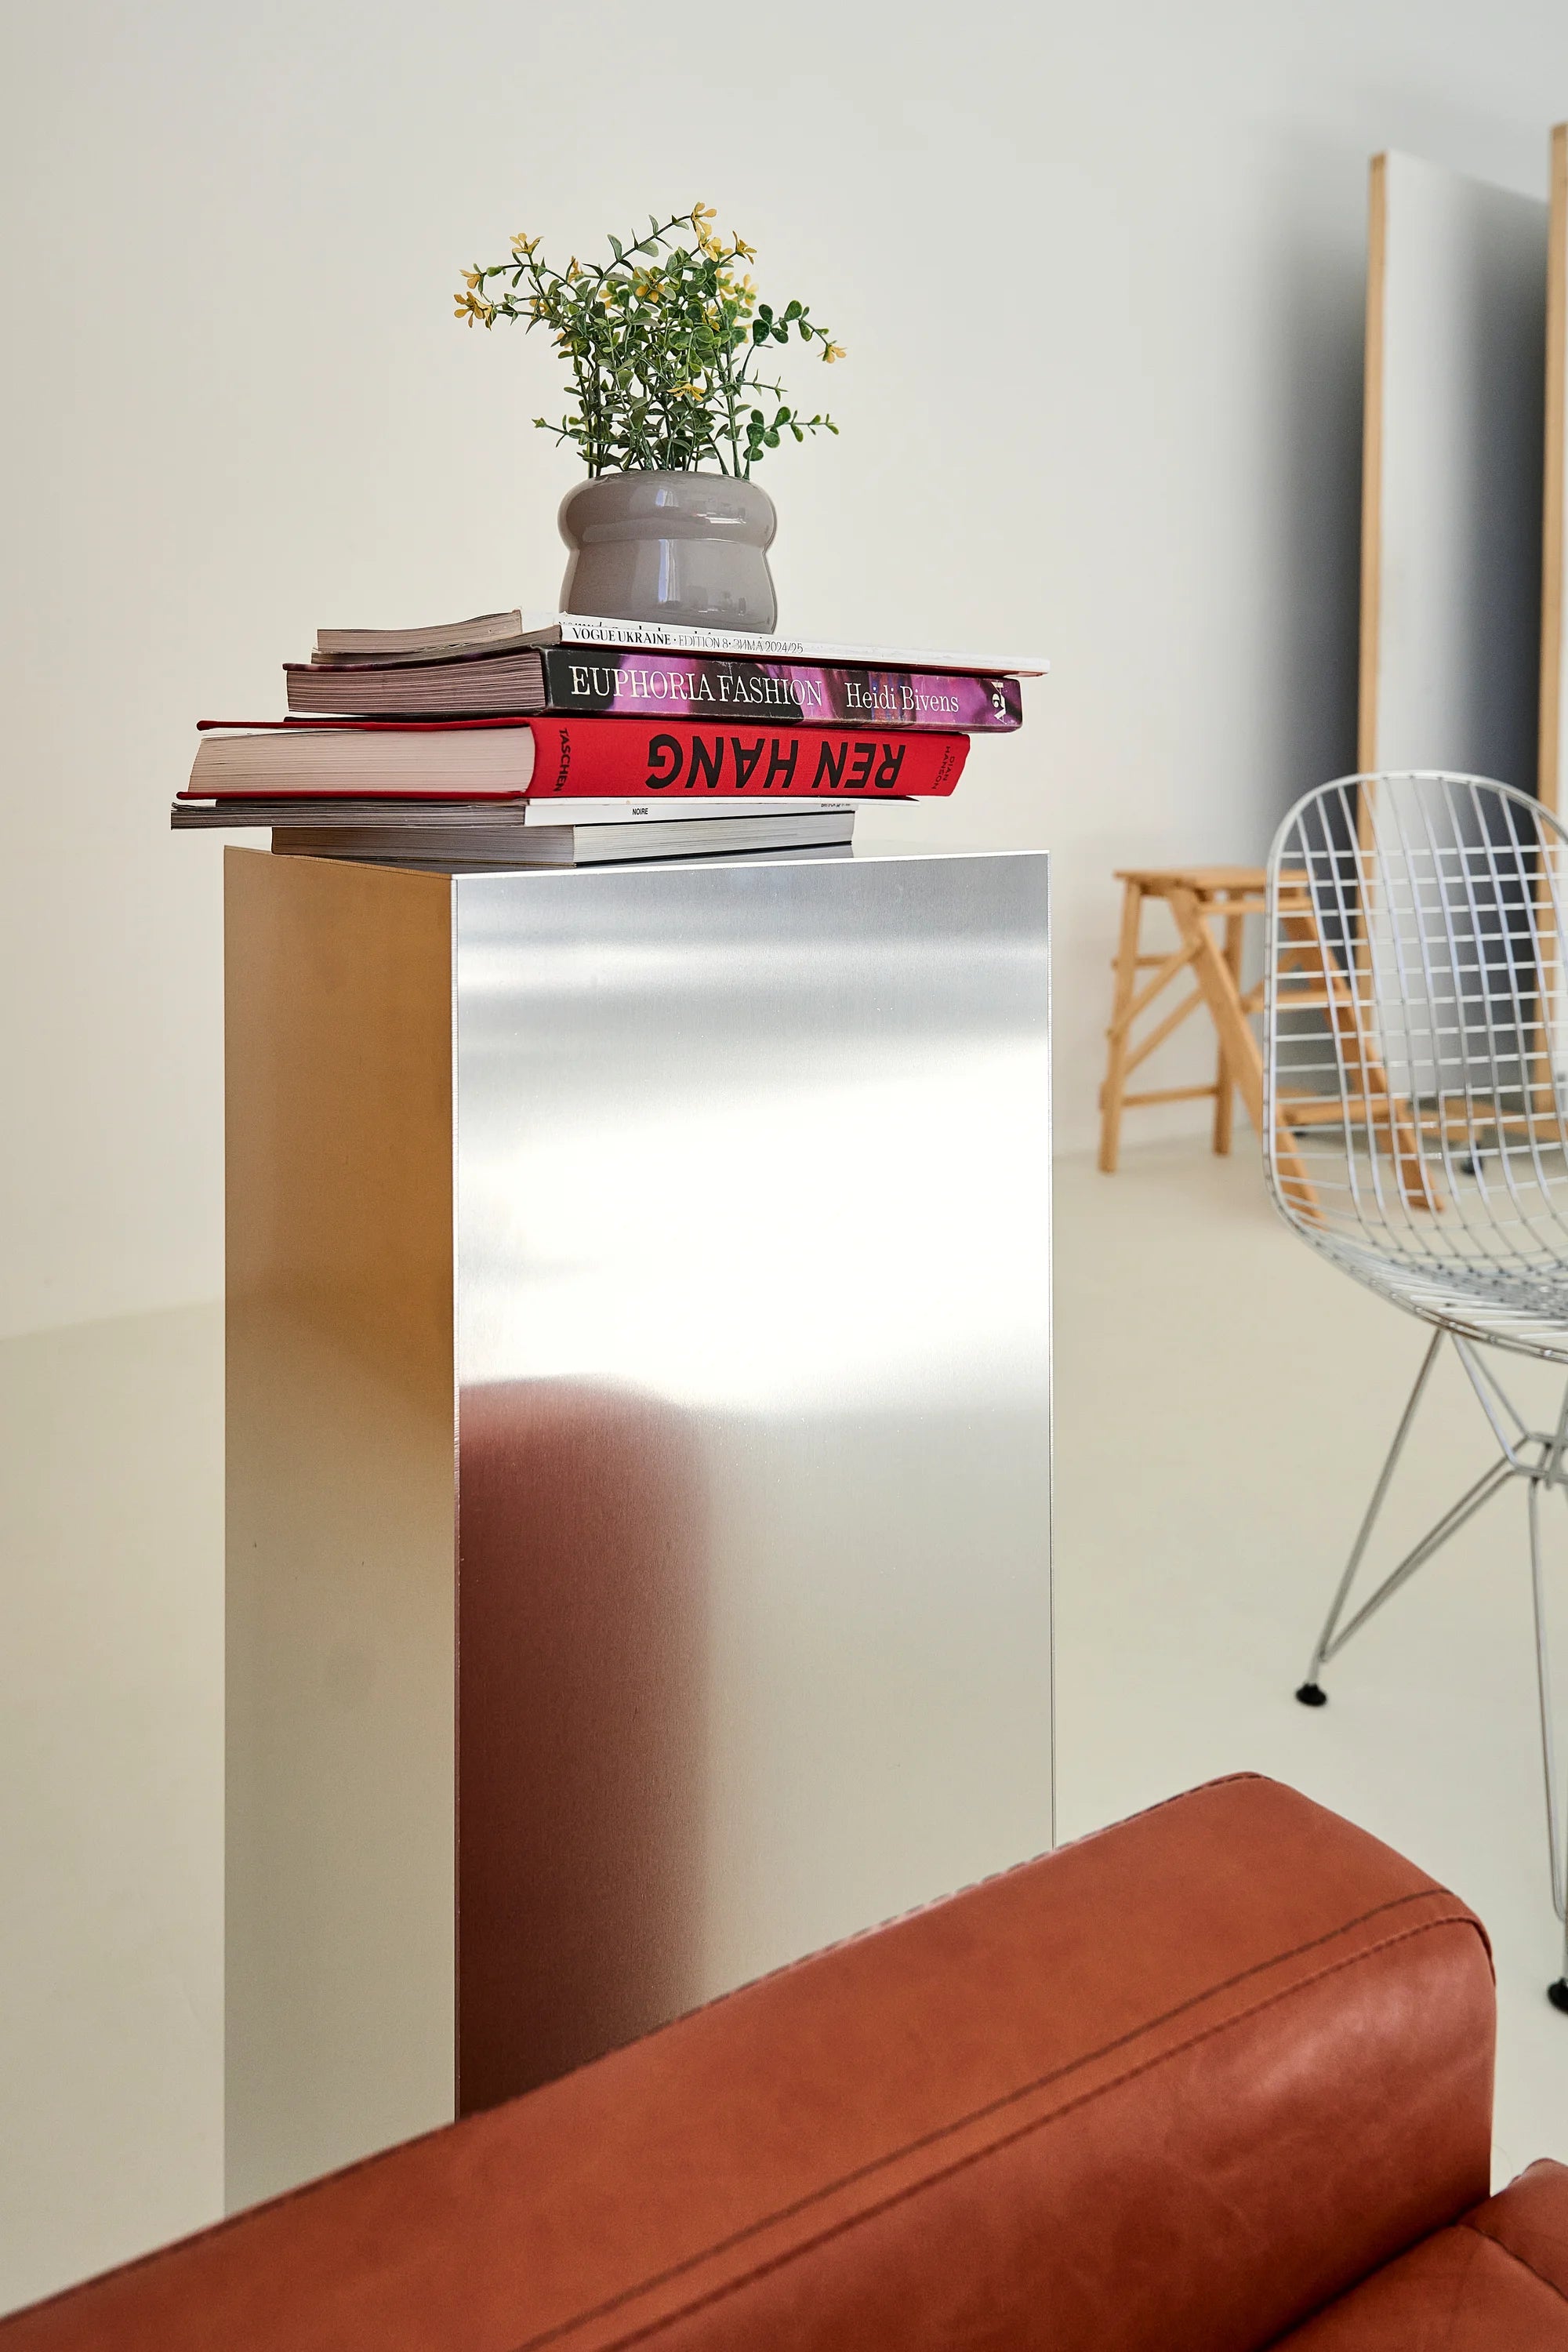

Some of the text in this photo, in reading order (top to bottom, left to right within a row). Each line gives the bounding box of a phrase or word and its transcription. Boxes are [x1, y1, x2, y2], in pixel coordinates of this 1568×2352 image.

[572, 627, 615, 642] VOGUE
[618, 630, 671, 645] UKRAINE
[679, 634, 720, 648] EDITION
[722, 637, 728, 649] 8
[733, 639, 764, 652] ЗИМА
[765, 641, 804, 654] 2024/25
[568, 665, 822, 706] EUPHORIA FASHION
[844, 681, 960, 713] Heidi Bivens
[553, 728, 572, 792] TASCHEN
[644, 733, 906, 789] REN HANG
[931, 746, 951, 789] HANSON
[943, 756, 955, 781] DIAN
